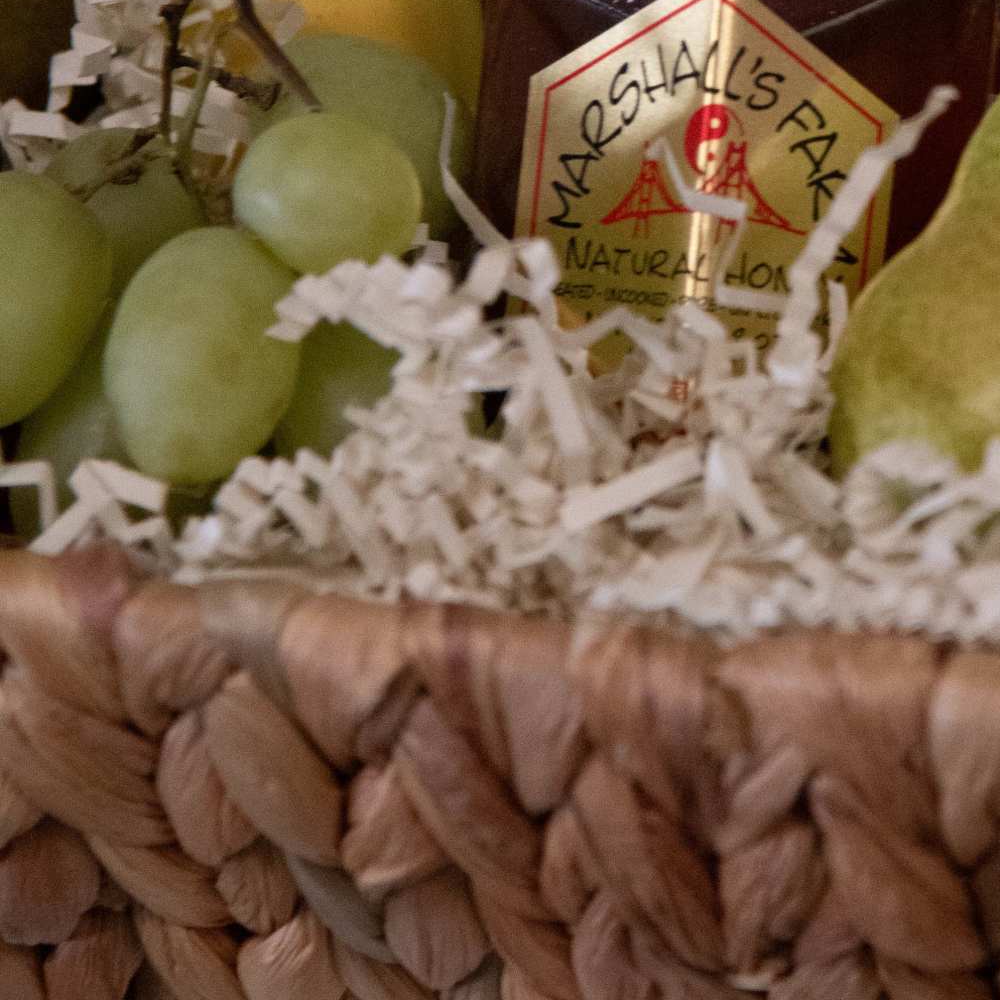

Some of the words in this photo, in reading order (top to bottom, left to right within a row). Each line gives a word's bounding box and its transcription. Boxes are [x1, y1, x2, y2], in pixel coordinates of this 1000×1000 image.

[548, 39, 785, 230] MARSHALL'S
[776, 99, 858, 264] FAR
[564, 235, 709, 283] NATURAL
[724, 258, 818, 295] HON
